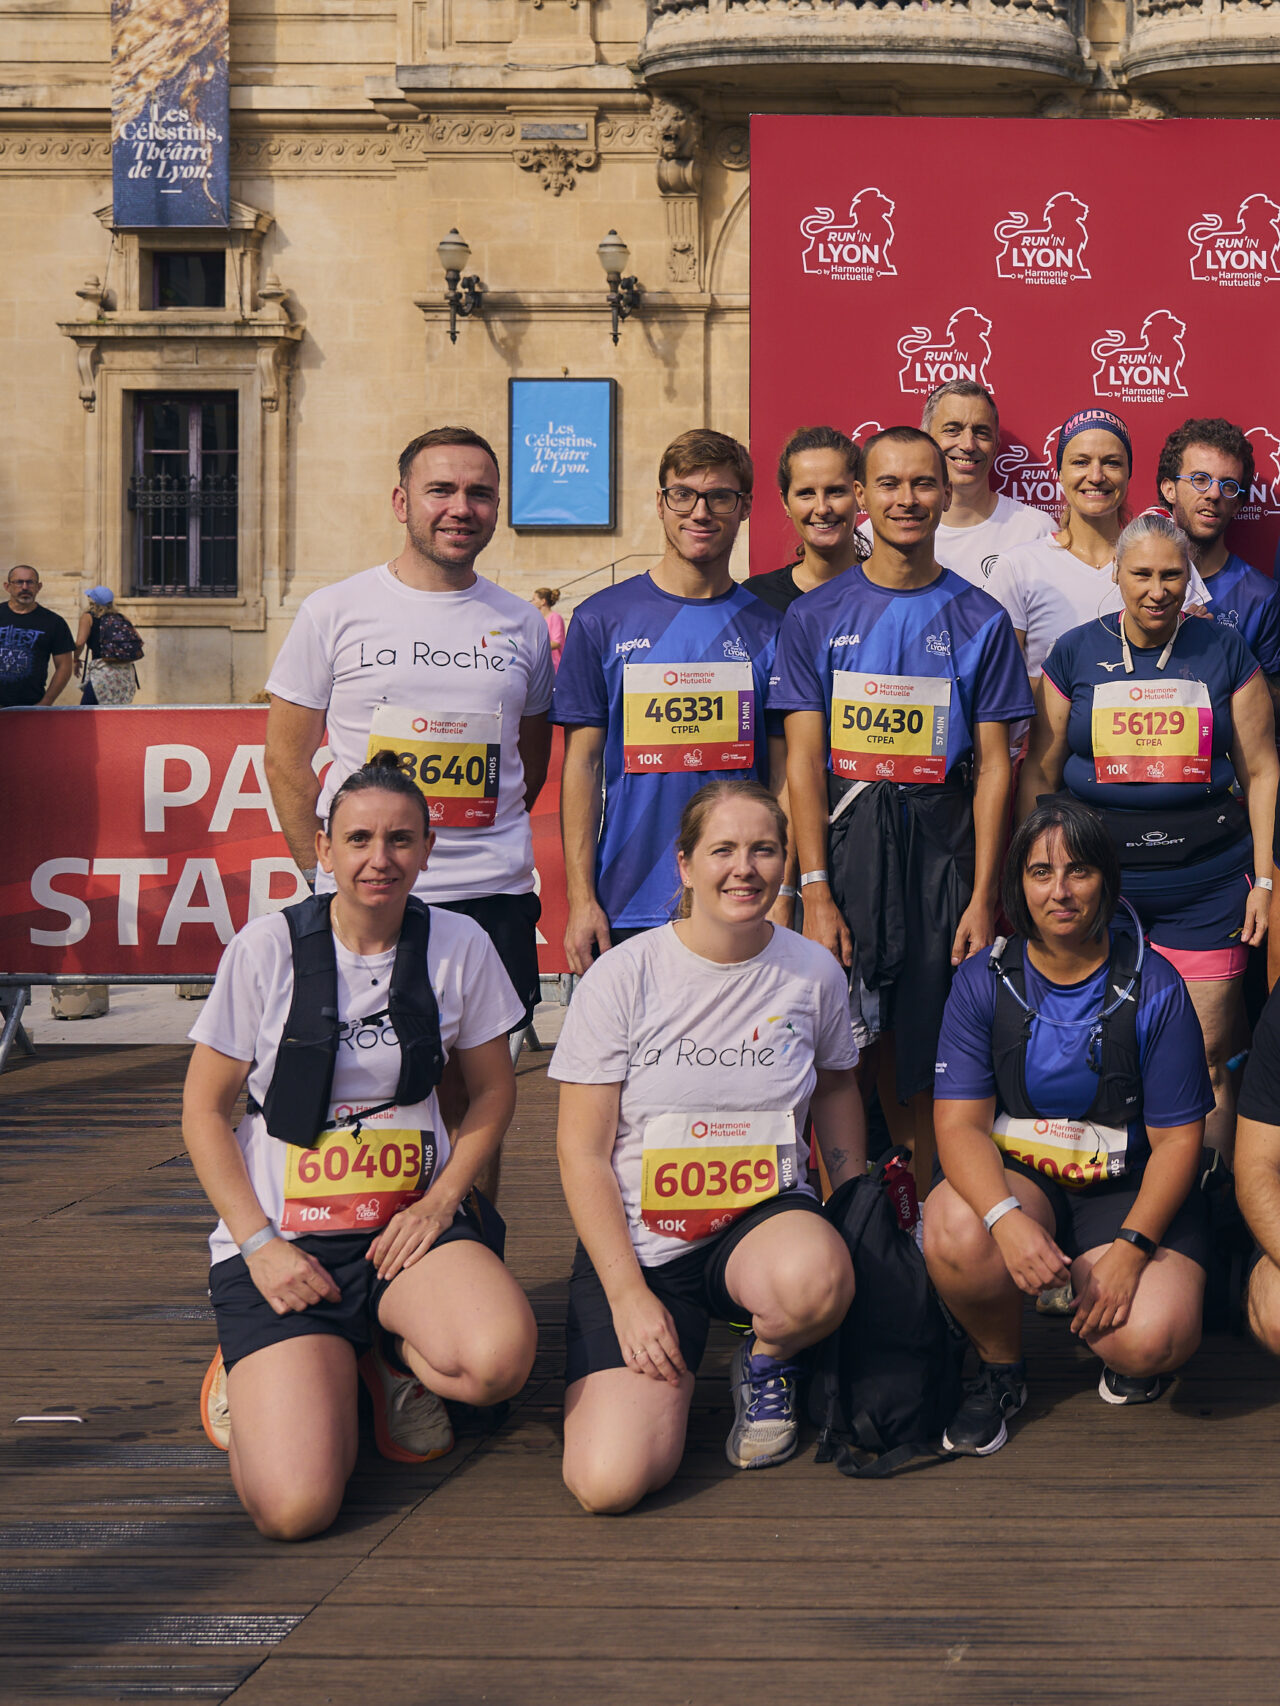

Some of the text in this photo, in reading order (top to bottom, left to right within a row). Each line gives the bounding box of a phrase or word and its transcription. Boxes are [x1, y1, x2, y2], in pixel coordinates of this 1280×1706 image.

[151, 103, 189, 123] Les
[119, 121, 223, 143] Célestins,
[132, 141, 212, 160] Théâtre
[127, 160, 213, 183] de Lyon.
[827, 230, 871, 243] RUN'IN
[1021, 234, 1065, 247] RUN'IN
[1215, 236, 1259, 249] RUN'IN
[818, 243, 879, 264] LYON
[1012, 248, 1073, 268] LYON
[1206, 250, 1267, 270] LYON
[831, 265, 874, 274] Harmonie
[1025, 269, 1068, 278] Harmonie
[1218, 271, 1262, 280] Harmonie
[831, 273, 873, 282] mutuelle
[1025, 277, 1067, 286] mutuelle
[1219, 279, 1261, 288] mutuelle
[924, 350, 969, 362] RUN'IN
[1117, 352, 1162, 365] RUN'IN
[915, 363, 976, 382] LYON
[1109, 366, 1170, 386] LYON
[1121, 387, 1165, 396] Harmonie
[1122, 394, 1164, 403] mutuelle
[548, 421, 574, 434] Les
[525, 434, 597, 448] Célestins,
[533, 447, 589, 460] Théâtre
[531, 460, 589, 477] de Lyon.
[615, 638, 651, 654] HOKA
[829, 634, 860, 649] HOKA
[360, 641, 506, 672] La Roche
[879, 682, 914, 691] Harmonie
[879, 689, 910, 697] Mutuelle
[1144, 687, 1177, 695] Harmonie
[644, 696, 723, 723] 46331
[742, 701, 750, 730] 51 MIN
[430, 720, 468, 729] Harmonie
[842, 704, 924, 734] 50430
[1112, 711, 1185, 736] 56129
[429, 726, 463, 734] Mutuelle
[671, 725, 700, 734] CTPEA
[935, 716, 945, 746] 57 MIN
[1202, 726, 1209, 736] 1H
[866, 735, 895, 744] CTPEA
[1135, 738, 1163, 747] CTPEA
[637, 753, 663, 765] 10K
[838, 758, 857, 771] 10K
[398, 752, 485, 786] 8640
[1106, 763, 1129, 775] 10K
[144, 743, 340, 833] PA
[1145, 837, 1185, 847] SPORT
[630, 1038, 775, 1067] La Roche
[710, 1121, 751, 1130] Harmonie
[1050, 1123, 1085, 1134] Harmonie
[710, 1129, 746, 1137] Mutuelle
[1049, 1129, 1082, 1140] Mutuelle
[298, 1143, 421, 1183] 60403
[654, 1159, 776, 1198] 60369
[782, 1157, 792, 1188] +1H05
[299, 1206, 331, 1221] 10K
[657, 1219, 686, 1232] 10K
